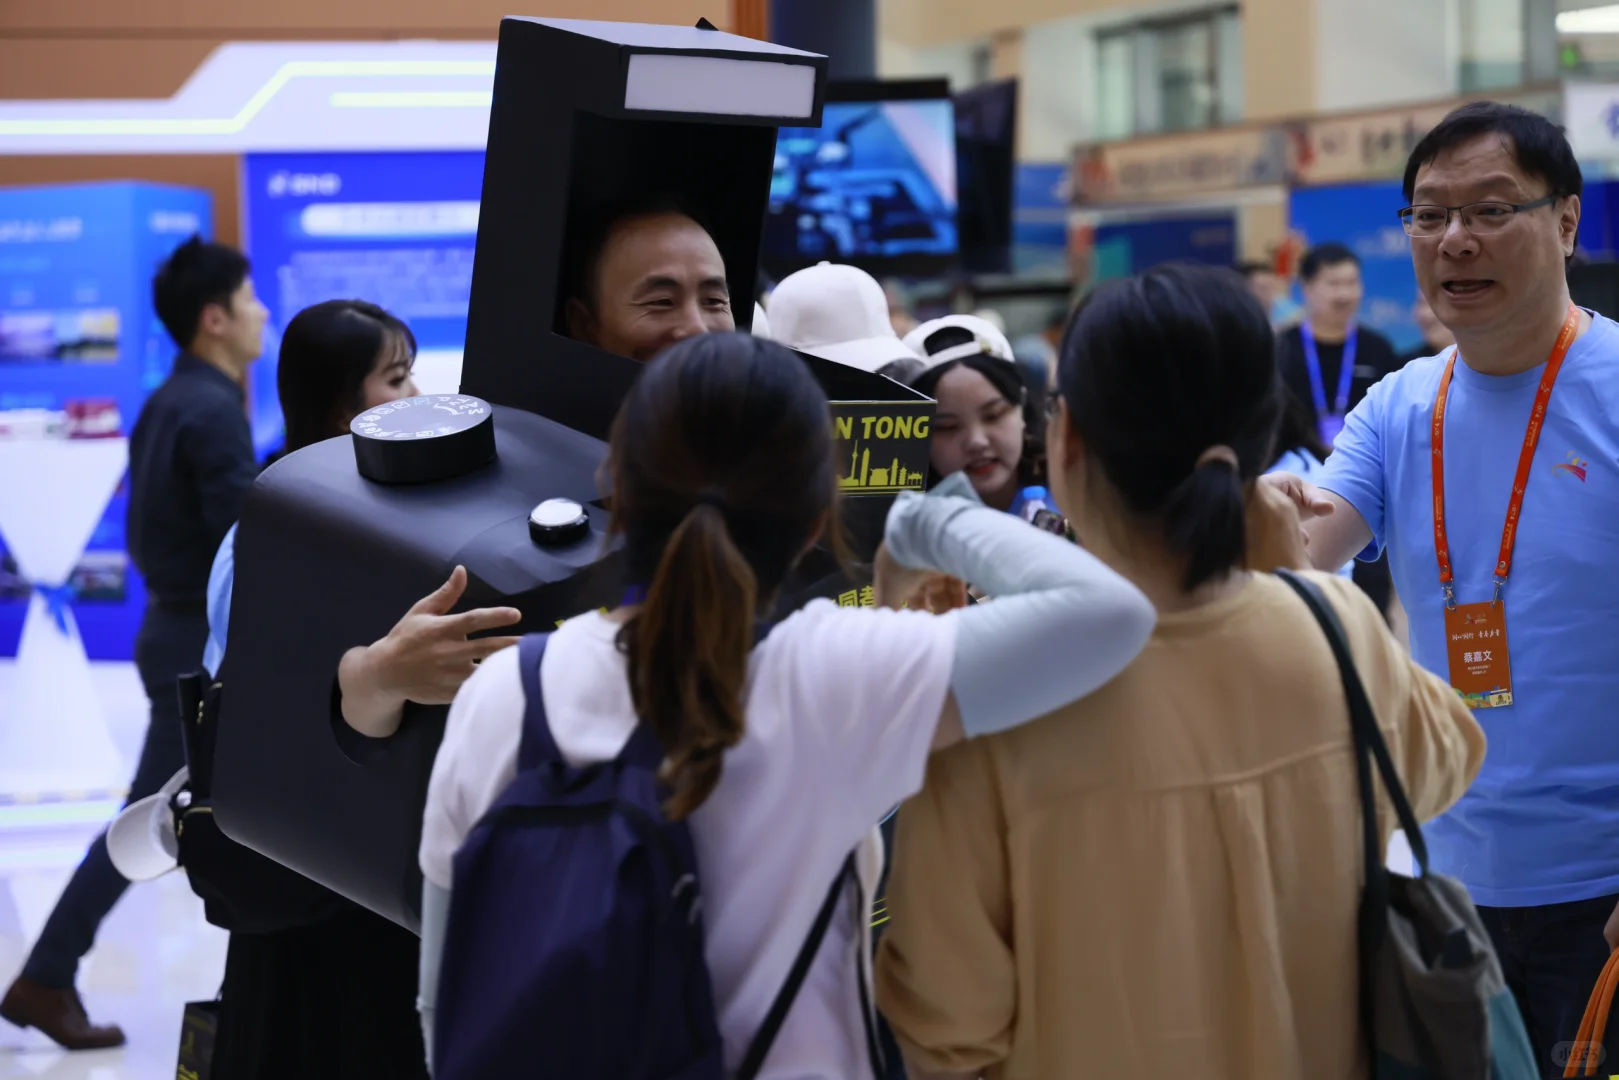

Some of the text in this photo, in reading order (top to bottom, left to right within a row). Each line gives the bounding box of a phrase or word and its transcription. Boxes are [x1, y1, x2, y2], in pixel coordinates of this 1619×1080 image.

[832, 416, 930, 440] N TONG
[833, 585, 876, 608] 同者
[1463, 650, 1493, 663] 蔡嘉文
